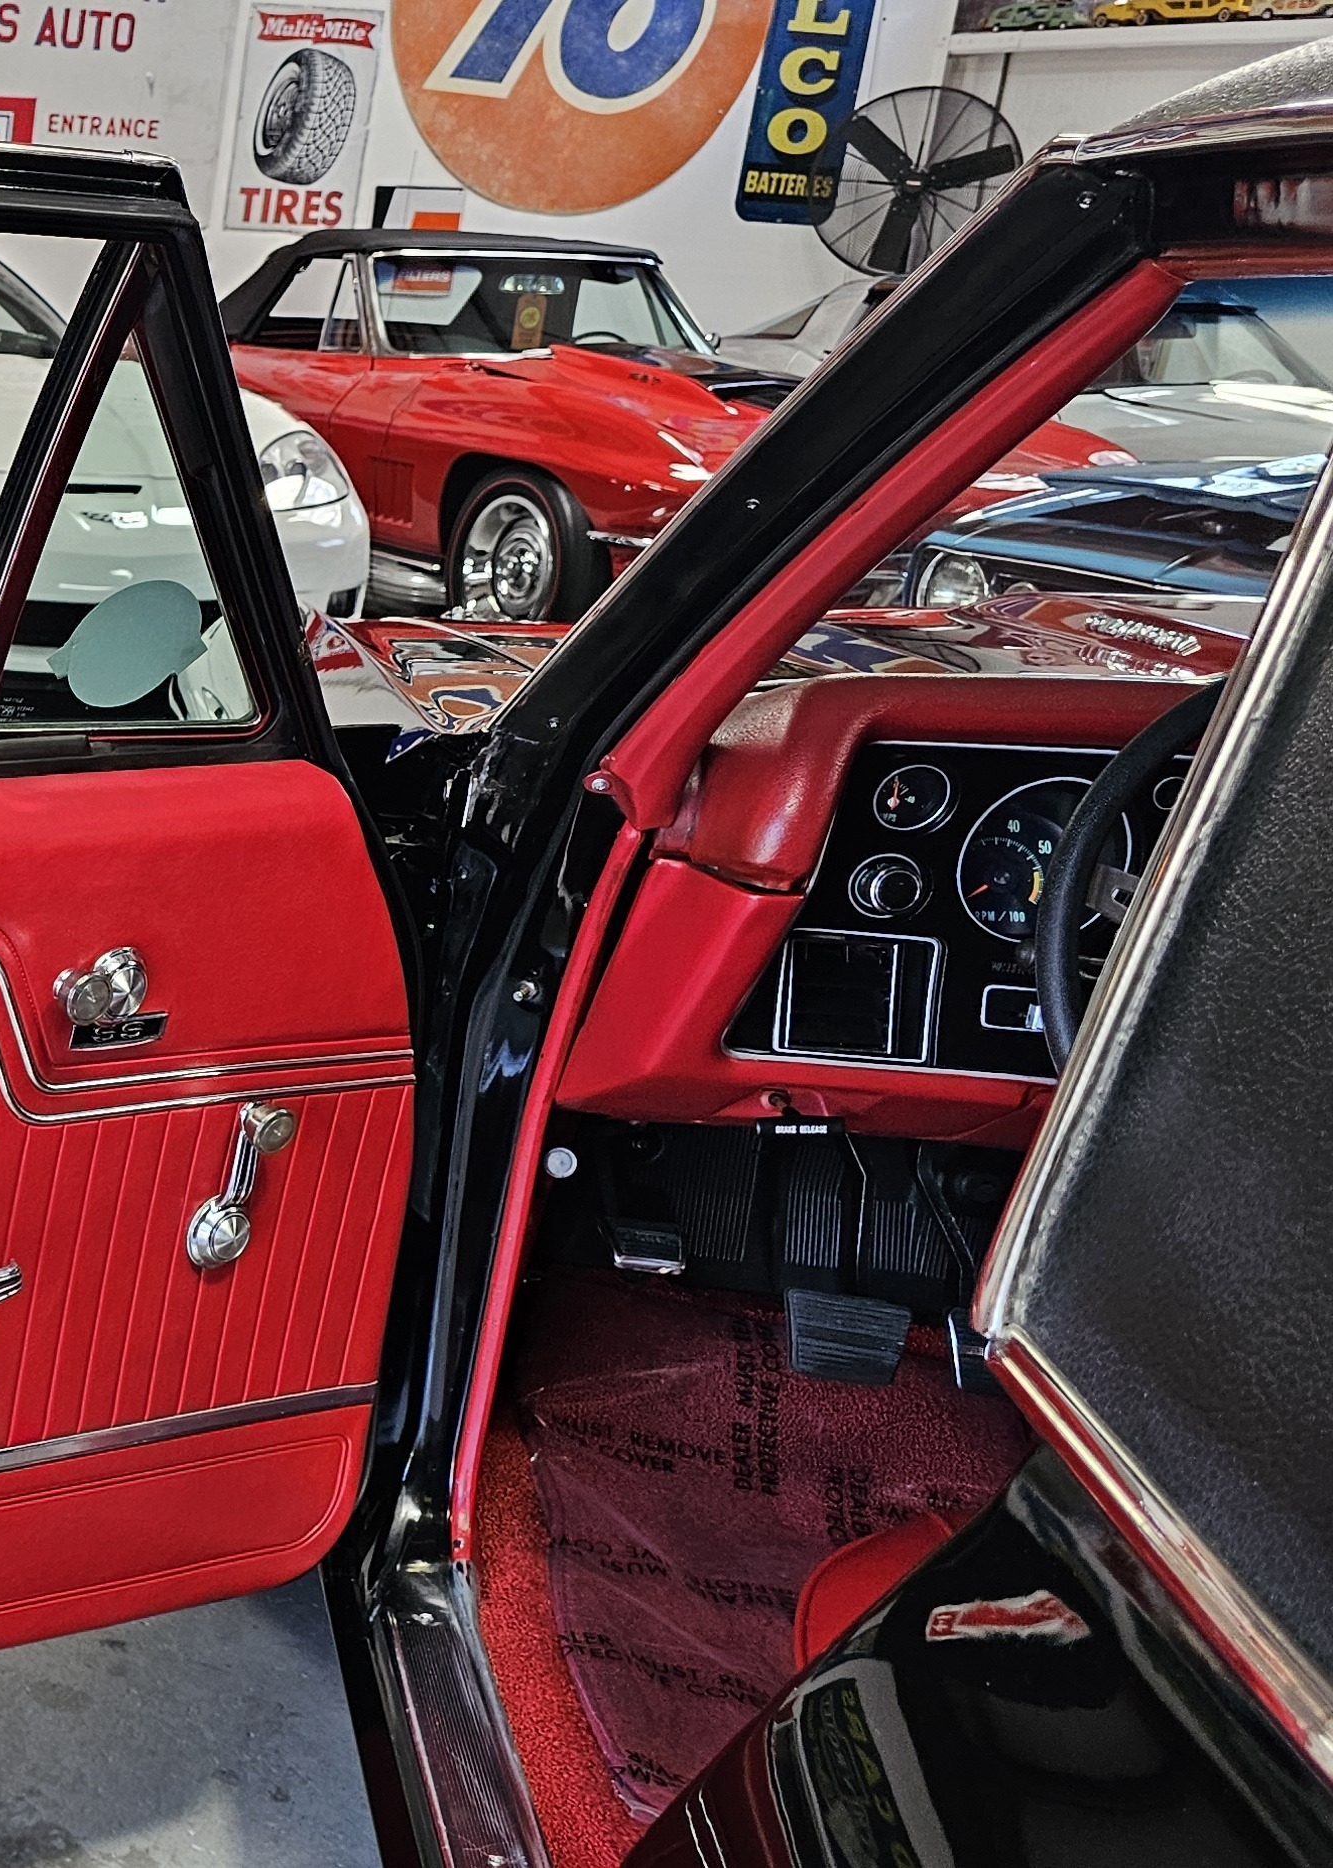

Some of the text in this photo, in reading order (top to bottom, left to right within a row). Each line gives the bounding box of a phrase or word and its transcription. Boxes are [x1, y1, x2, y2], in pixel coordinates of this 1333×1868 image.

[34, 6, 136, 52] AUTO
[263, 17, 367, 42] Multi-Mile
[47, 113, 159, 140] ENTRANCE
[744, 170, 833, 198] BATTERES
[239, 187, 343, 227] TIRES
[1007, 819, 1020, 833] 40
[1037, 840, 1052, 854] 50
[974, 910, 996, 922] RPM
[1008, 910, 1026, 923] 100
[736, 1350, 755, 1410] MUST
[630, 1429, 728, 1467] REMOVE
